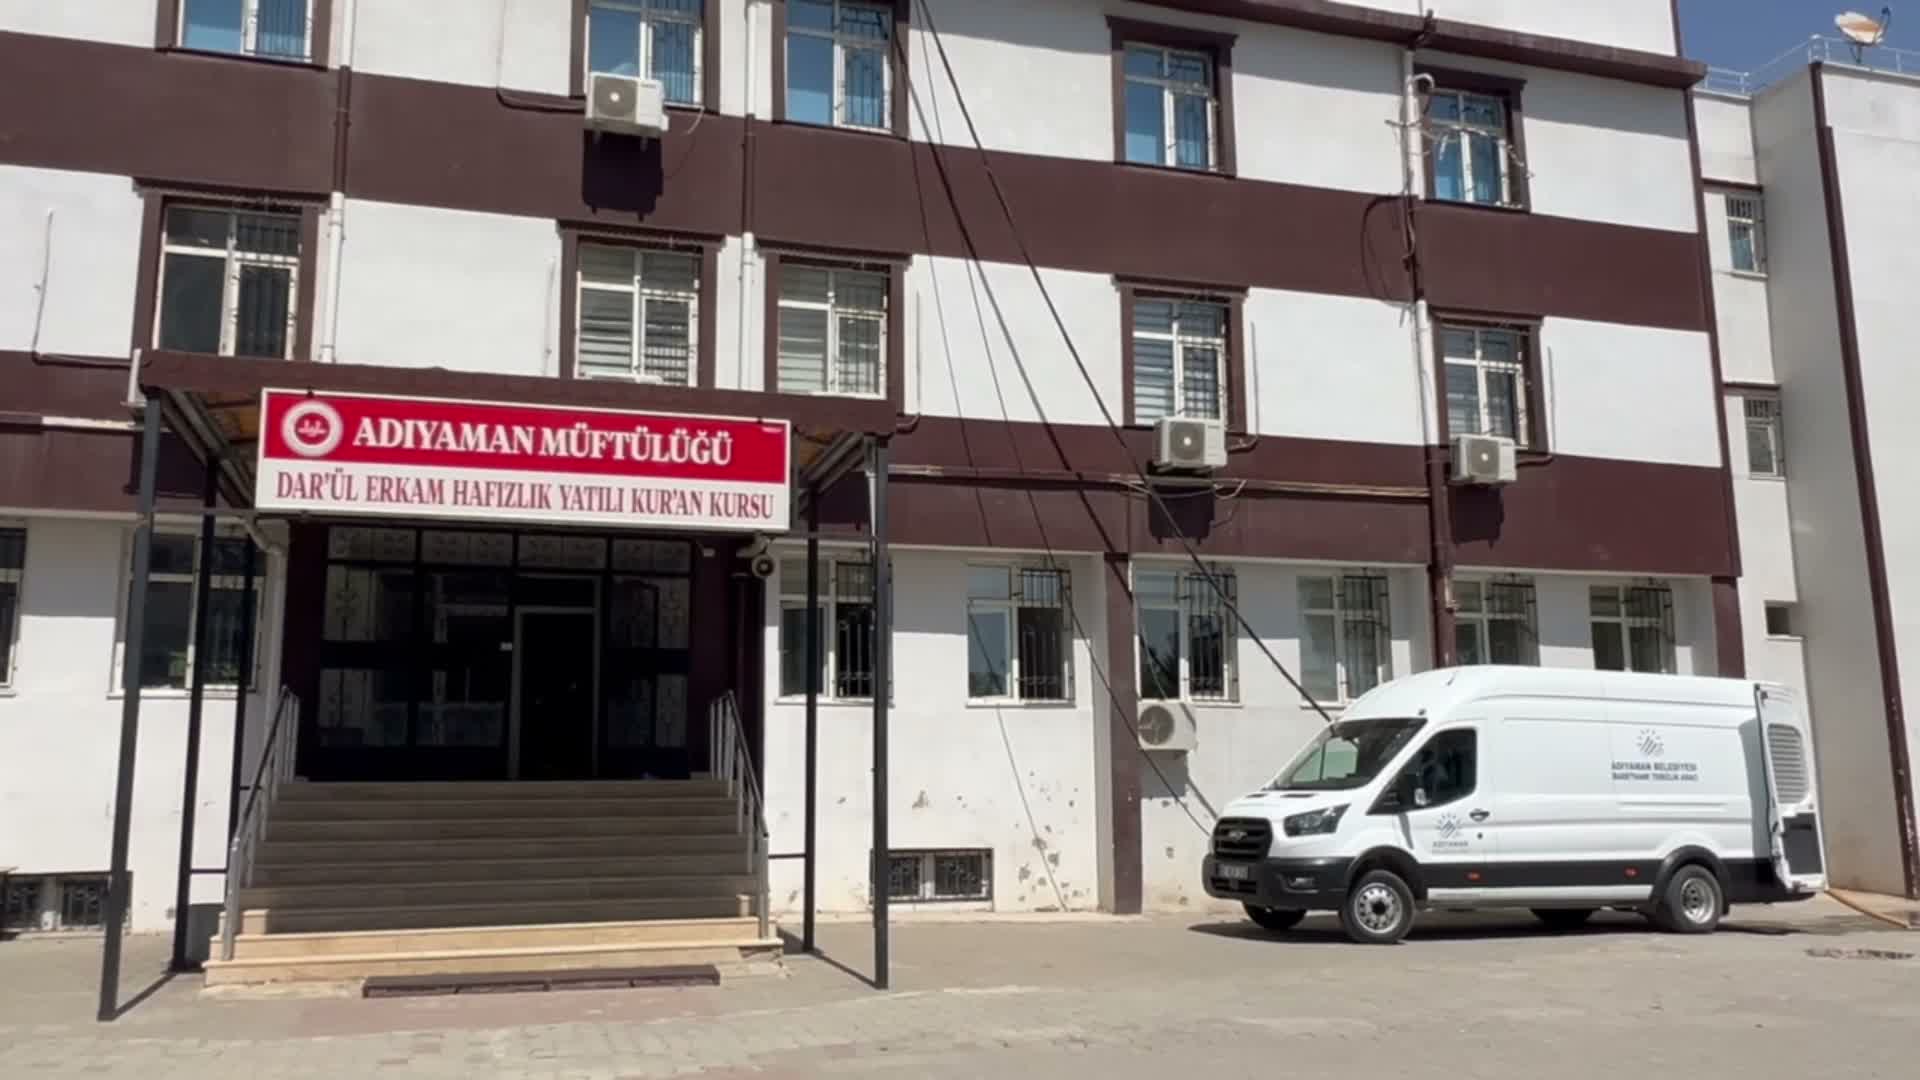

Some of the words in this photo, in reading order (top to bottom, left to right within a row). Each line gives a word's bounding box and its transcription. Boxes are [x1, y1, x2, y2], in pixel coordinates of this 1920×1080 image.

[352, 416, 536, 455] ADIYAMAN
[541, 422, 733, 466] MÜFTÜLÜĞÜ
[276, 468, 358, 501] DAR'ÜL
[366, 475, 444, 505] ERKAM
[453, 479, 551, 510] HAFIZLIK
[559, 484, 624, 513] YATILI
[631, 487, 703, 516] KUR'AN
[709, 491, 775, 519] KURSU
